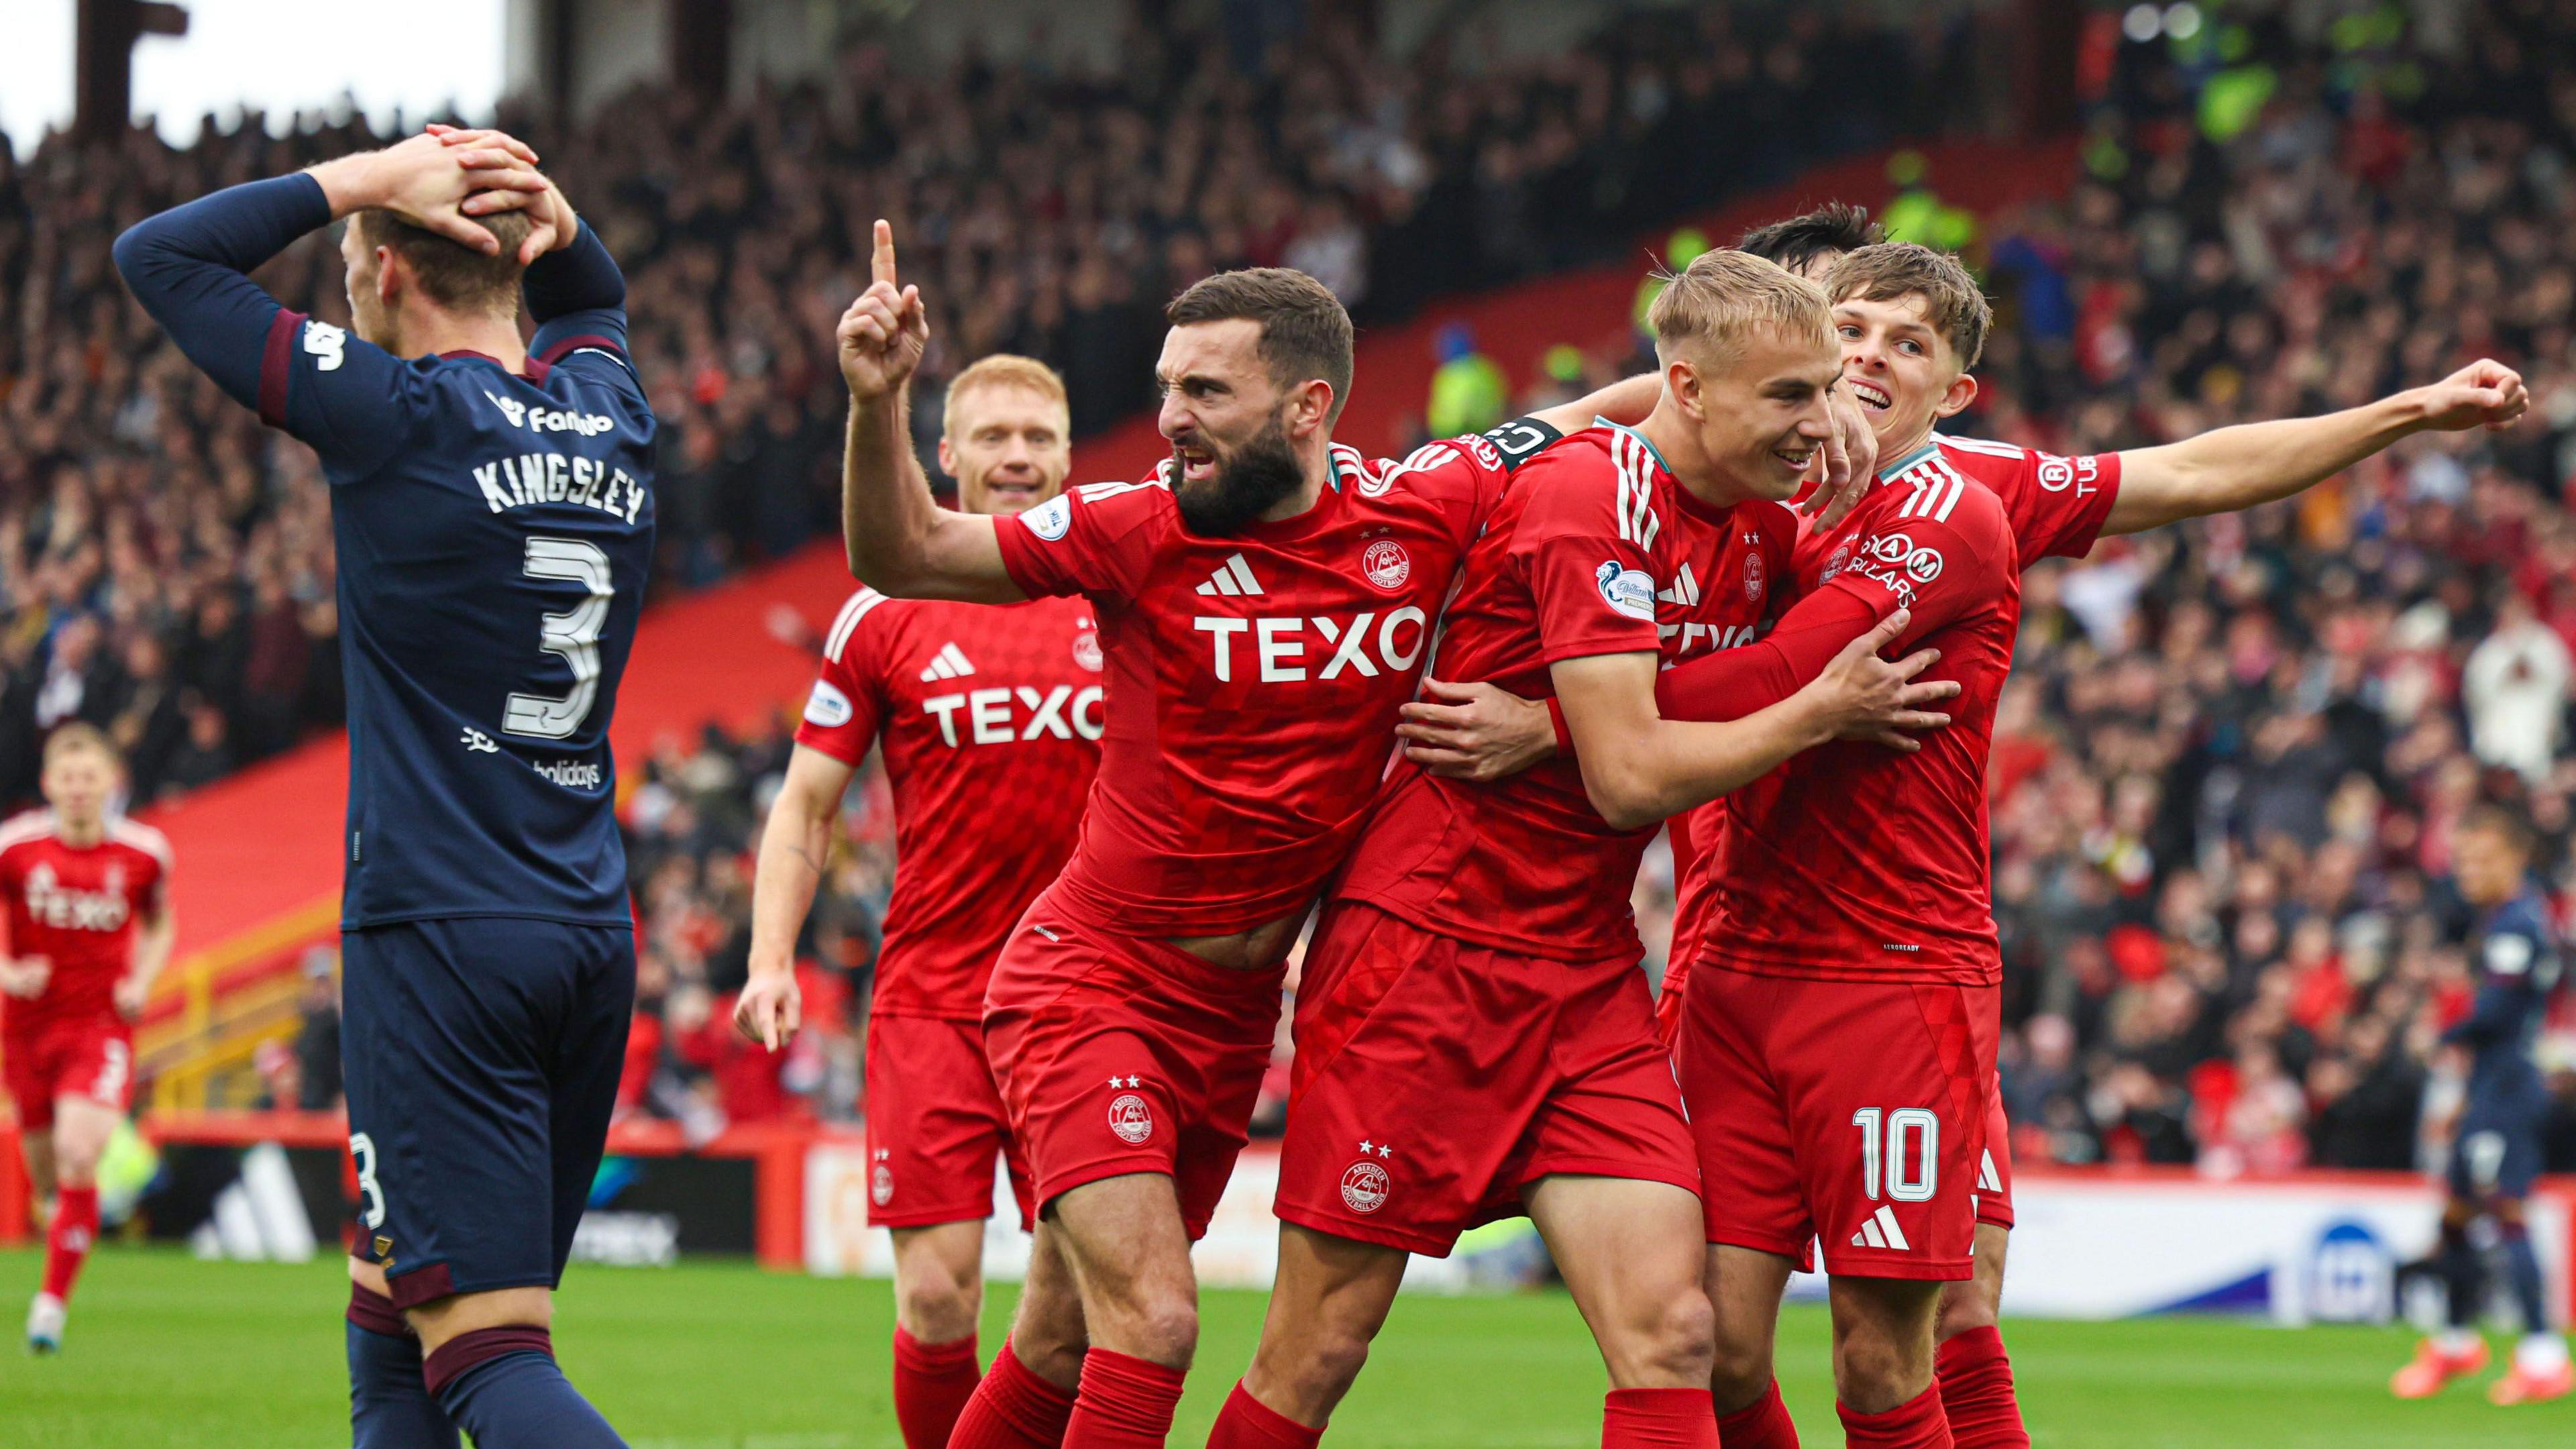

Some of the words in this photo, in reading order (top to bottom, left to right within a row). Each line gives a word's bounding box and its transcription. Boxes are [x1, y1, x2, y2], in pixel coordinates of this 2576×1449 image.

[472, 453, 645, 525] KINGSLEY
[1367, 543, 1398, 559] ABERDEEN
[502, 537, 615, 739] 3
[1193, 606, 1426, 683] TEXO
[923, 685, 1104, 749] TEXO
[1353, 1165, 1386, 1181] ABERDEEN
[1852, 1107, 1939, 1201] 10
[1342, 1185, 1370, 1210] FOOTBALL
[1370, 1193, 1386, 1209] CLUB
